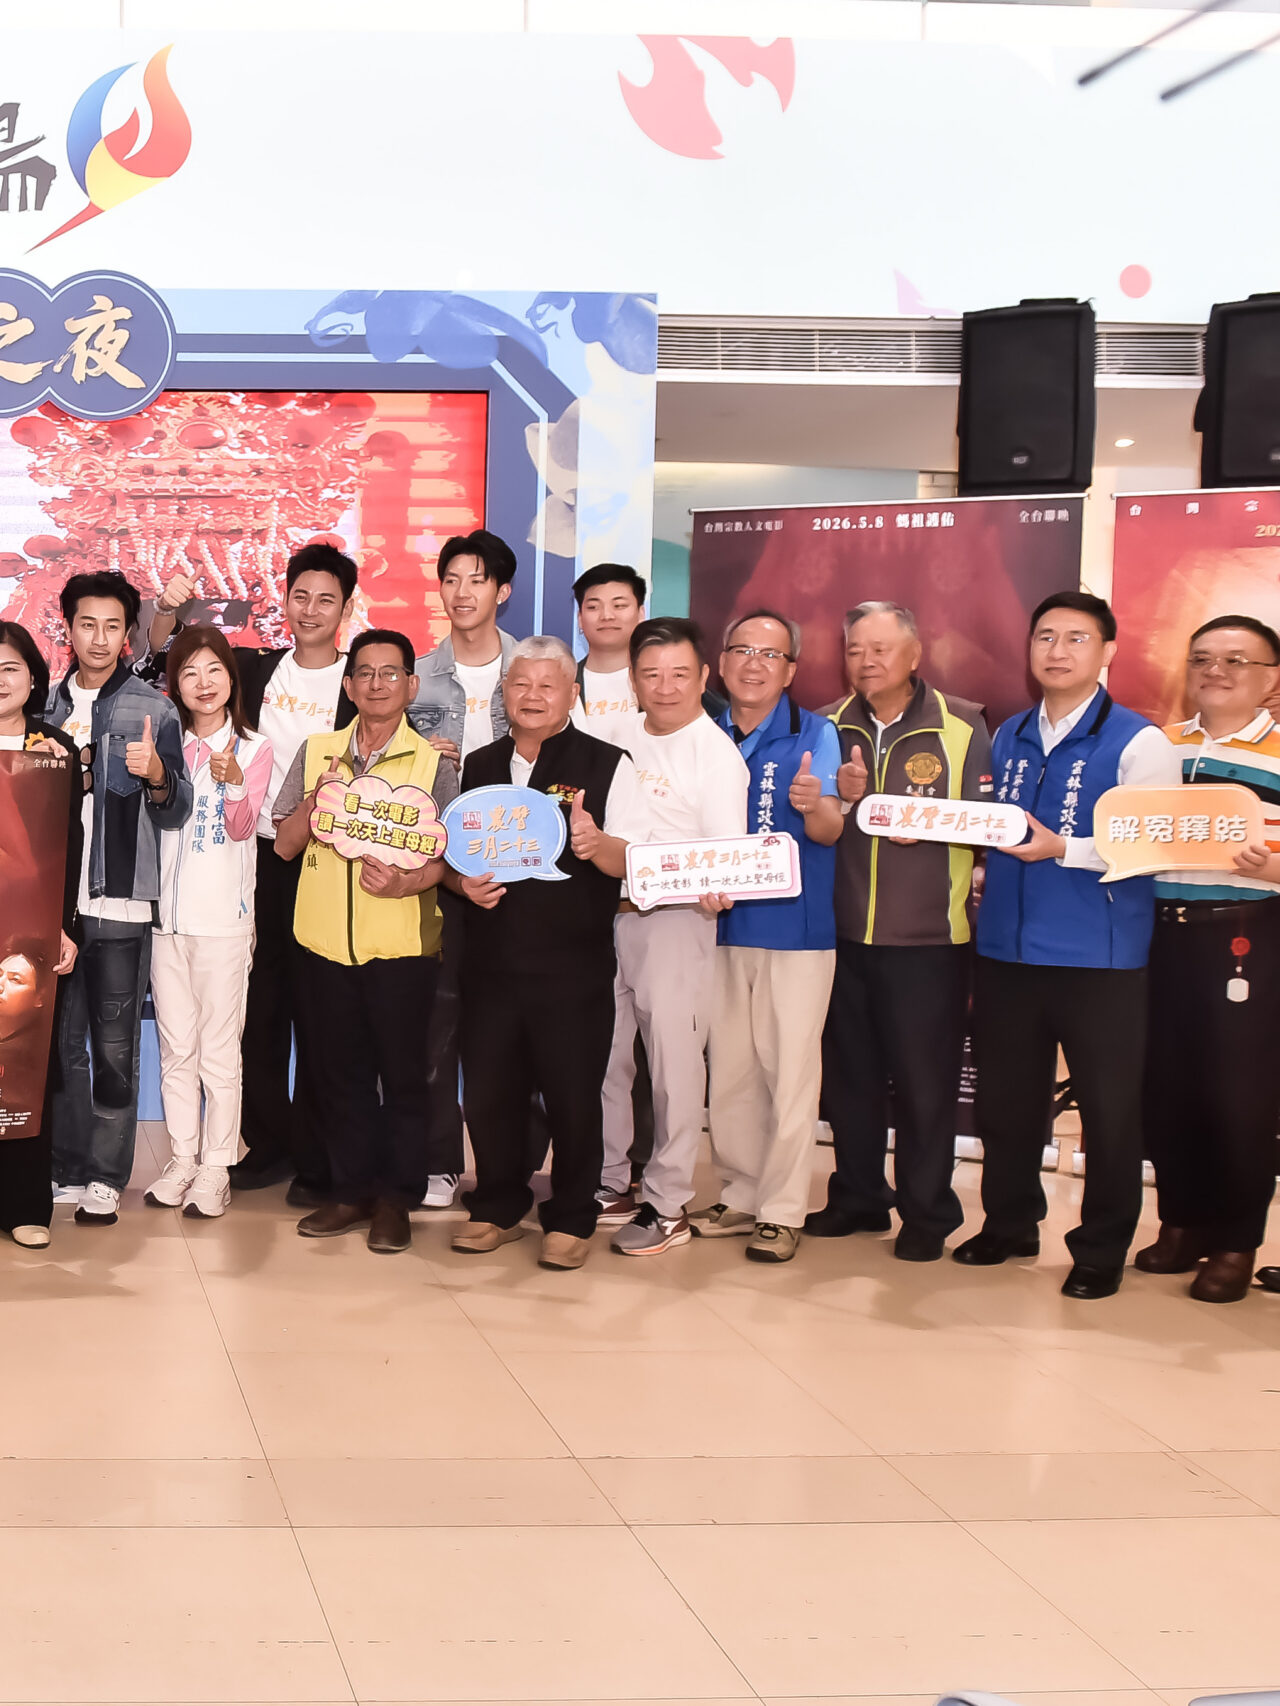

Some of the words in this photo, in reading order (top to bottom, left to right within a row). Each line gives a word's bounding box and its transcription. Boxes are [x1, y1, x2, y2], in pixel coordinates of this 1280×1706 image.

[812, 516, 884, 531] 2026.5.8
[895, 512, 955, 528] 媽祖護佑
[191, 795, 209, 853] 服務團隊
[344, 793, 420, 827] 看一次電影
[317, 811, 438, 856] 讀一次天上聖母經
[1108, 814, 1249, 843] 解冤釋結
[466, 835, 541, 860] 三月二十三
